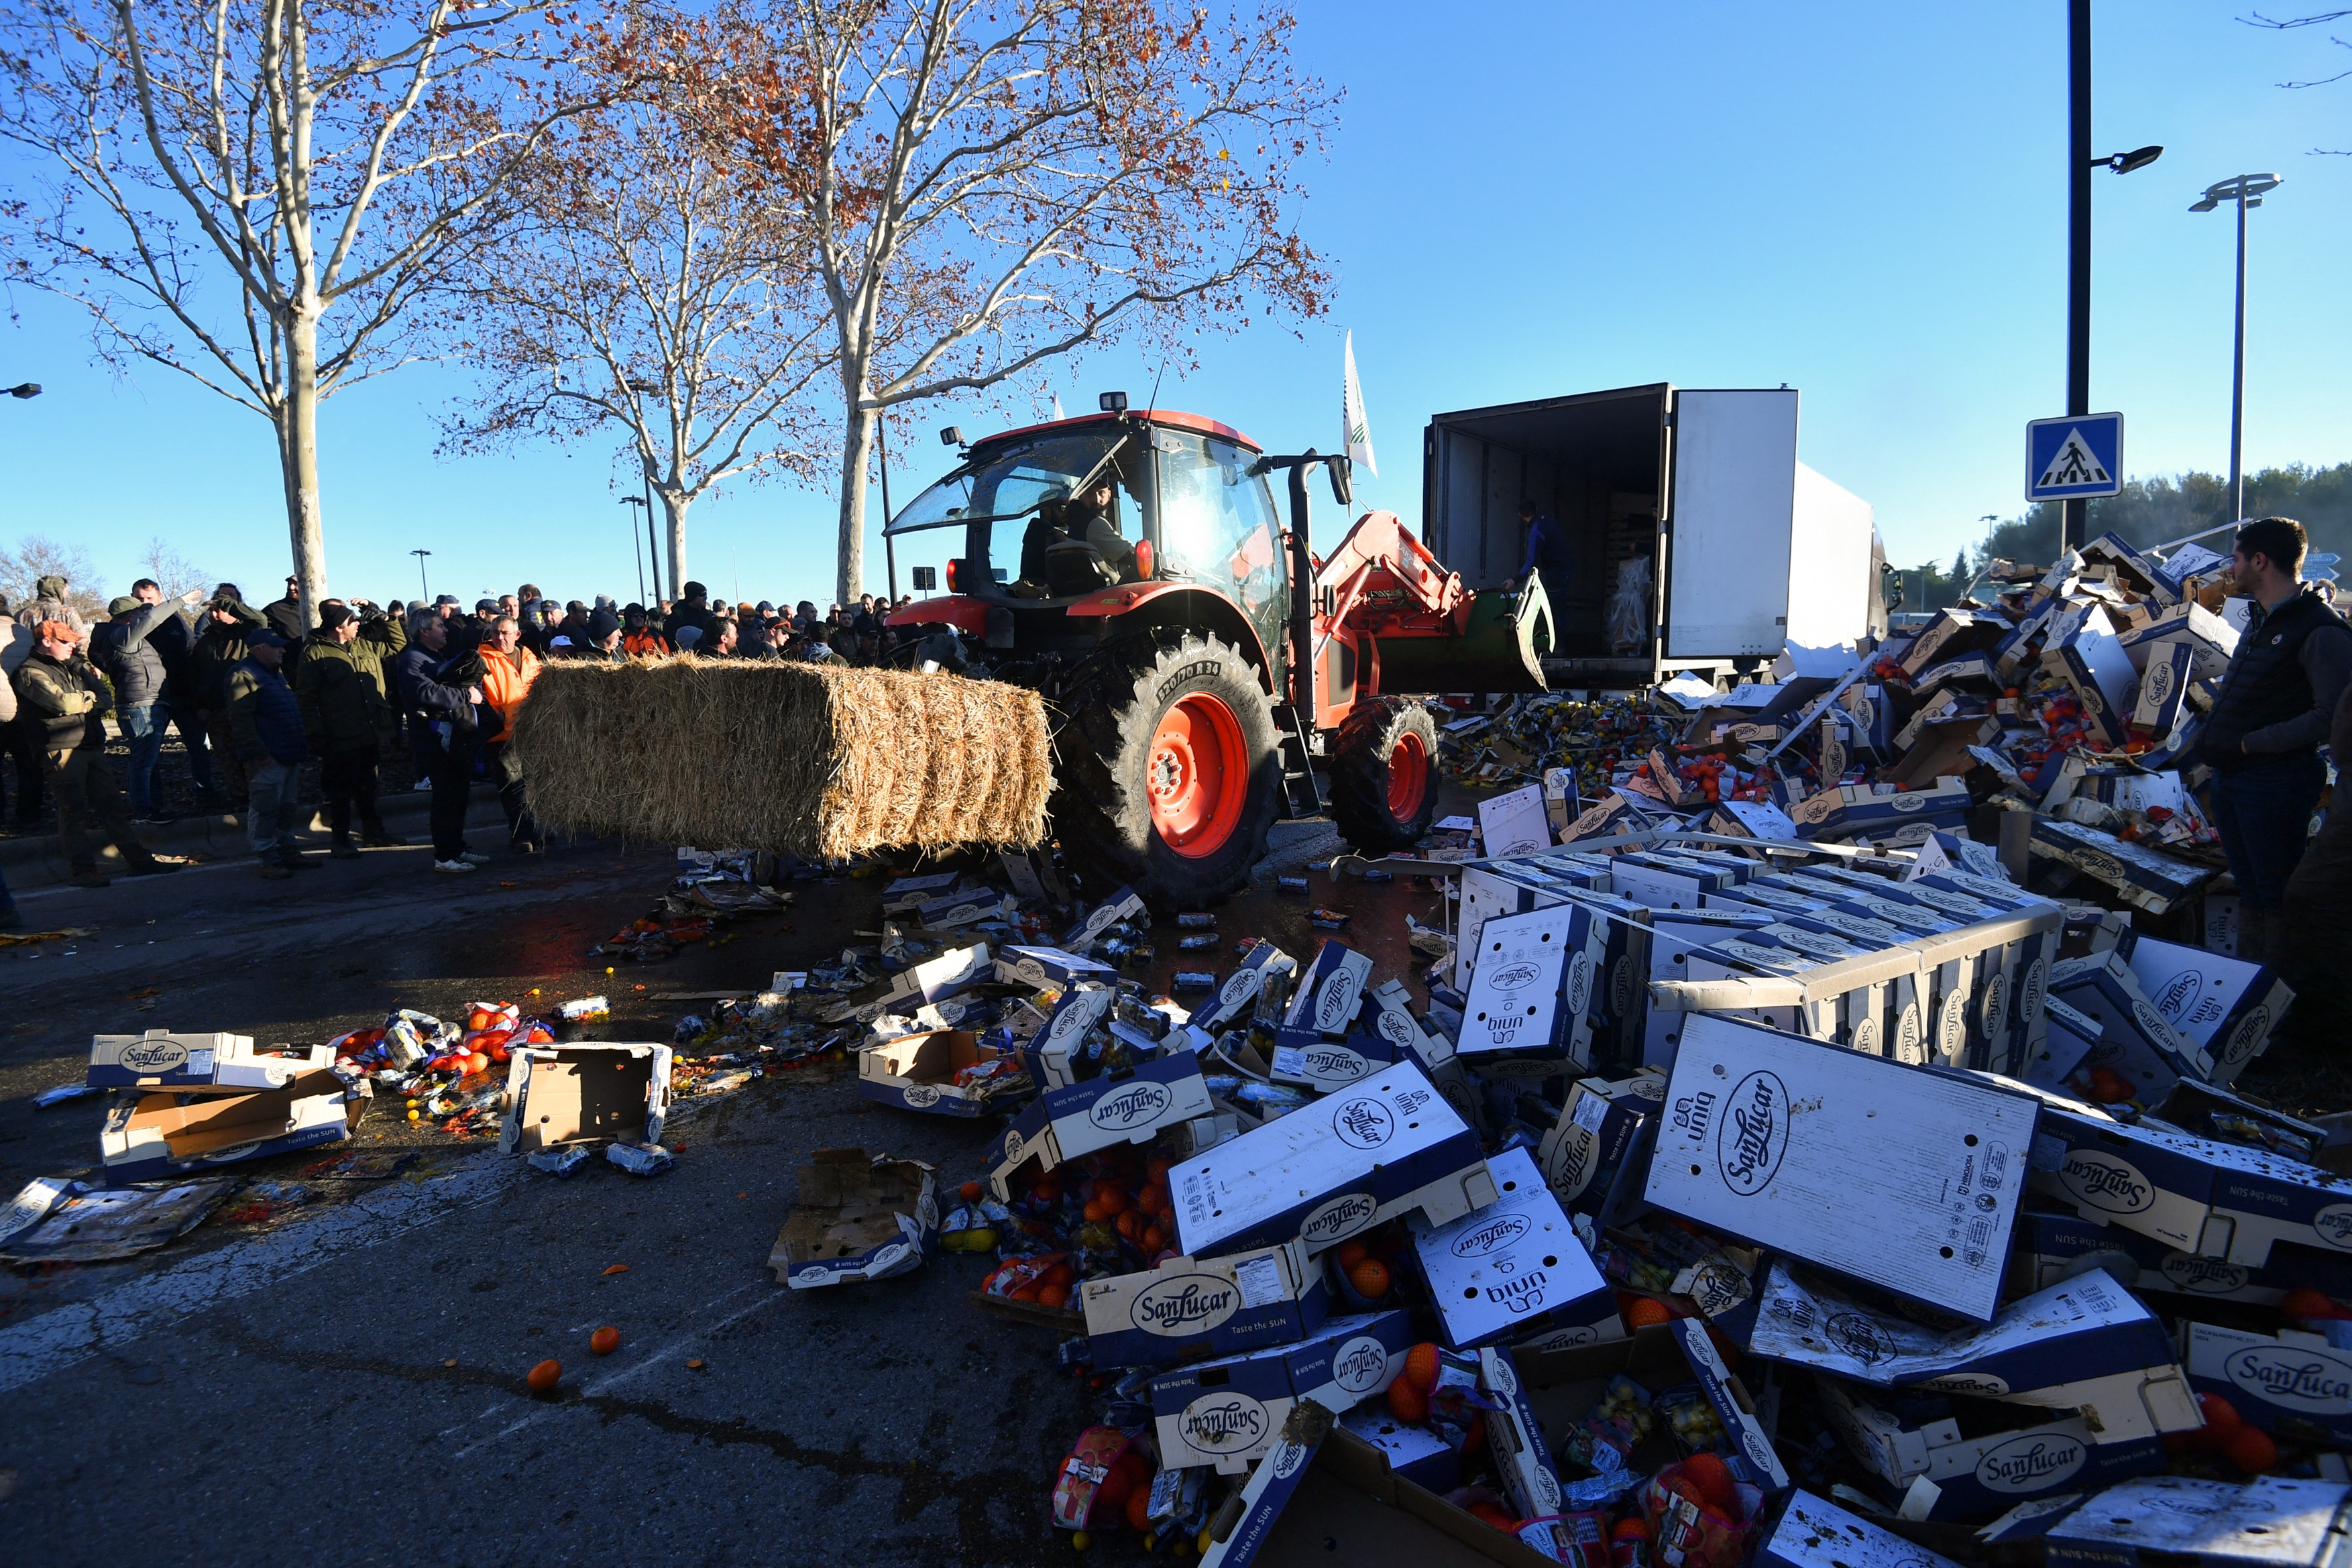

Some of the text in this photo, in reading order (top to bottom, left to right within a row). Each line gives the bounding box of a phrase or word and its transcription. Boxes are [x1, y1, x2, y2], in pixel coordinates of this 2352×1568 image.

[1915, 630, 1939, 657] SanLucar
[1159, 662, 1220, 702] 520/70 R 34
[2149, 665, 2169, 703] SanLucar
[1859, 698, 1868, 730] SanLucar
[1831, 743, 1842, 775] SanLucar
[1805, 804, 1829, 820] SanLucar
[1894, 796, 1923, 808] SanLucar
[1579, 810, 1608, 832] SanLucar
[1898, 825, 1935, 838] SanLucar
[1440, 854, 1463, 862] SanLuca
[948, 907, 976, 919] SanLucar
[1088, 907, 1114, 928] SanLucar
[1420, 940, 1447, 954] SanLuca
[1019, 960, 1044, 978] SanLucar
[1493, 966, 1536, 986] SanLucar
[1570, 956, 1587, 1012] SanLucar
[1223, 971, 1255, 1003] SanLucar
[1323, 972, 1351, 1025] SanLucar
[1615, 958, 1630, 1013] SanLucar
[2025, 964, 2041, 1018] SanLucar
[2159, 974, 2198, 1016] SanLuc
[858, 1004, 885, 1021] SanLucar
[1056, 1001, 1086, 1036] SanLucar
[1946, 995, 1961, 1050] SanLucar
[1986, 979, 2003, 1034] SanLucar
[2188, 996, 2217, 1024] uniq
[1382, 1013, 1409, 1044] SanLucar
[1488, 1017, 1522, 1031] uniq
[2135, 1003, 2176, 1049] SanLucar
[2227, 1009, 2267, 1061] SanLucar
[124, 1044, 183, 1067] SanLucar
[1306, 1053, 1363, 1075] SanLuca
[906, 1086, 938, 1103] SanLucar
[1054, 1090, 1095, 1107] Taste the SUN
[1097, 1087, 1164, 1123] SanLucar
[1395, 1092, 1418, 1116] uniq
[1346, 1101, 1384, 1147] SanLucar
[1687, 1091, 1716, 1142] uniq
[1728, 1078, 1774, 1186] SanLucar
[1609, 1124, 1628, 1162] Taste the SUN
[1961, 1154, 1974, 1186] HINOJOSA
[2062, 1159, 2145, 1207] SanLucar
[2229, 1186, 2288, 1205] Taste the SUN
[0, 1198, 44, 1234] SanLucar
[1305, 1198, 1371, 1239] SanLucar
[1459, 1220, 1524, 1254] SanLucar
[2055, 1233, 2125, 1250] Taste the SUN
[1486, 1272, 1547, 1302] uniq
[1141, 1284, 1231, 1327] SanLucar
[1231, 1317, 1286, 1335] Taste the SUN
[1339, 1343, 1384, 1383] SanLucar
[1689, 1334, 1711, 1365] SanLucar
[1160, 1382, 1171, 1390] SUN
[1498, 1359, 1515, 1392] SanLucar
[2239, 1355, 2350, 1398] SanLuca
[1705, 1374, 1731, 1416] Taste the SUN
[1186, 1402, 1259, 1443] SanLucar
[1524, 1412, 1533, 1426] SUN
[1274, 1439, 1305, 1476] SanLuca
[1486, 1409, 1516, 1492] SanLuca
[1535, 1439, 1545, 1456] Taste
[1744, 1435, 1771, 1469] SanLucar
[1986, 1443, 2078, 1483] SanLucar
[2099, 1450, 2147, 1467] Taste the SUN
[1539, 1468, 1558, 1505] SanLucar
[1234, 1505, 1273, 1564] Taste the SUN
